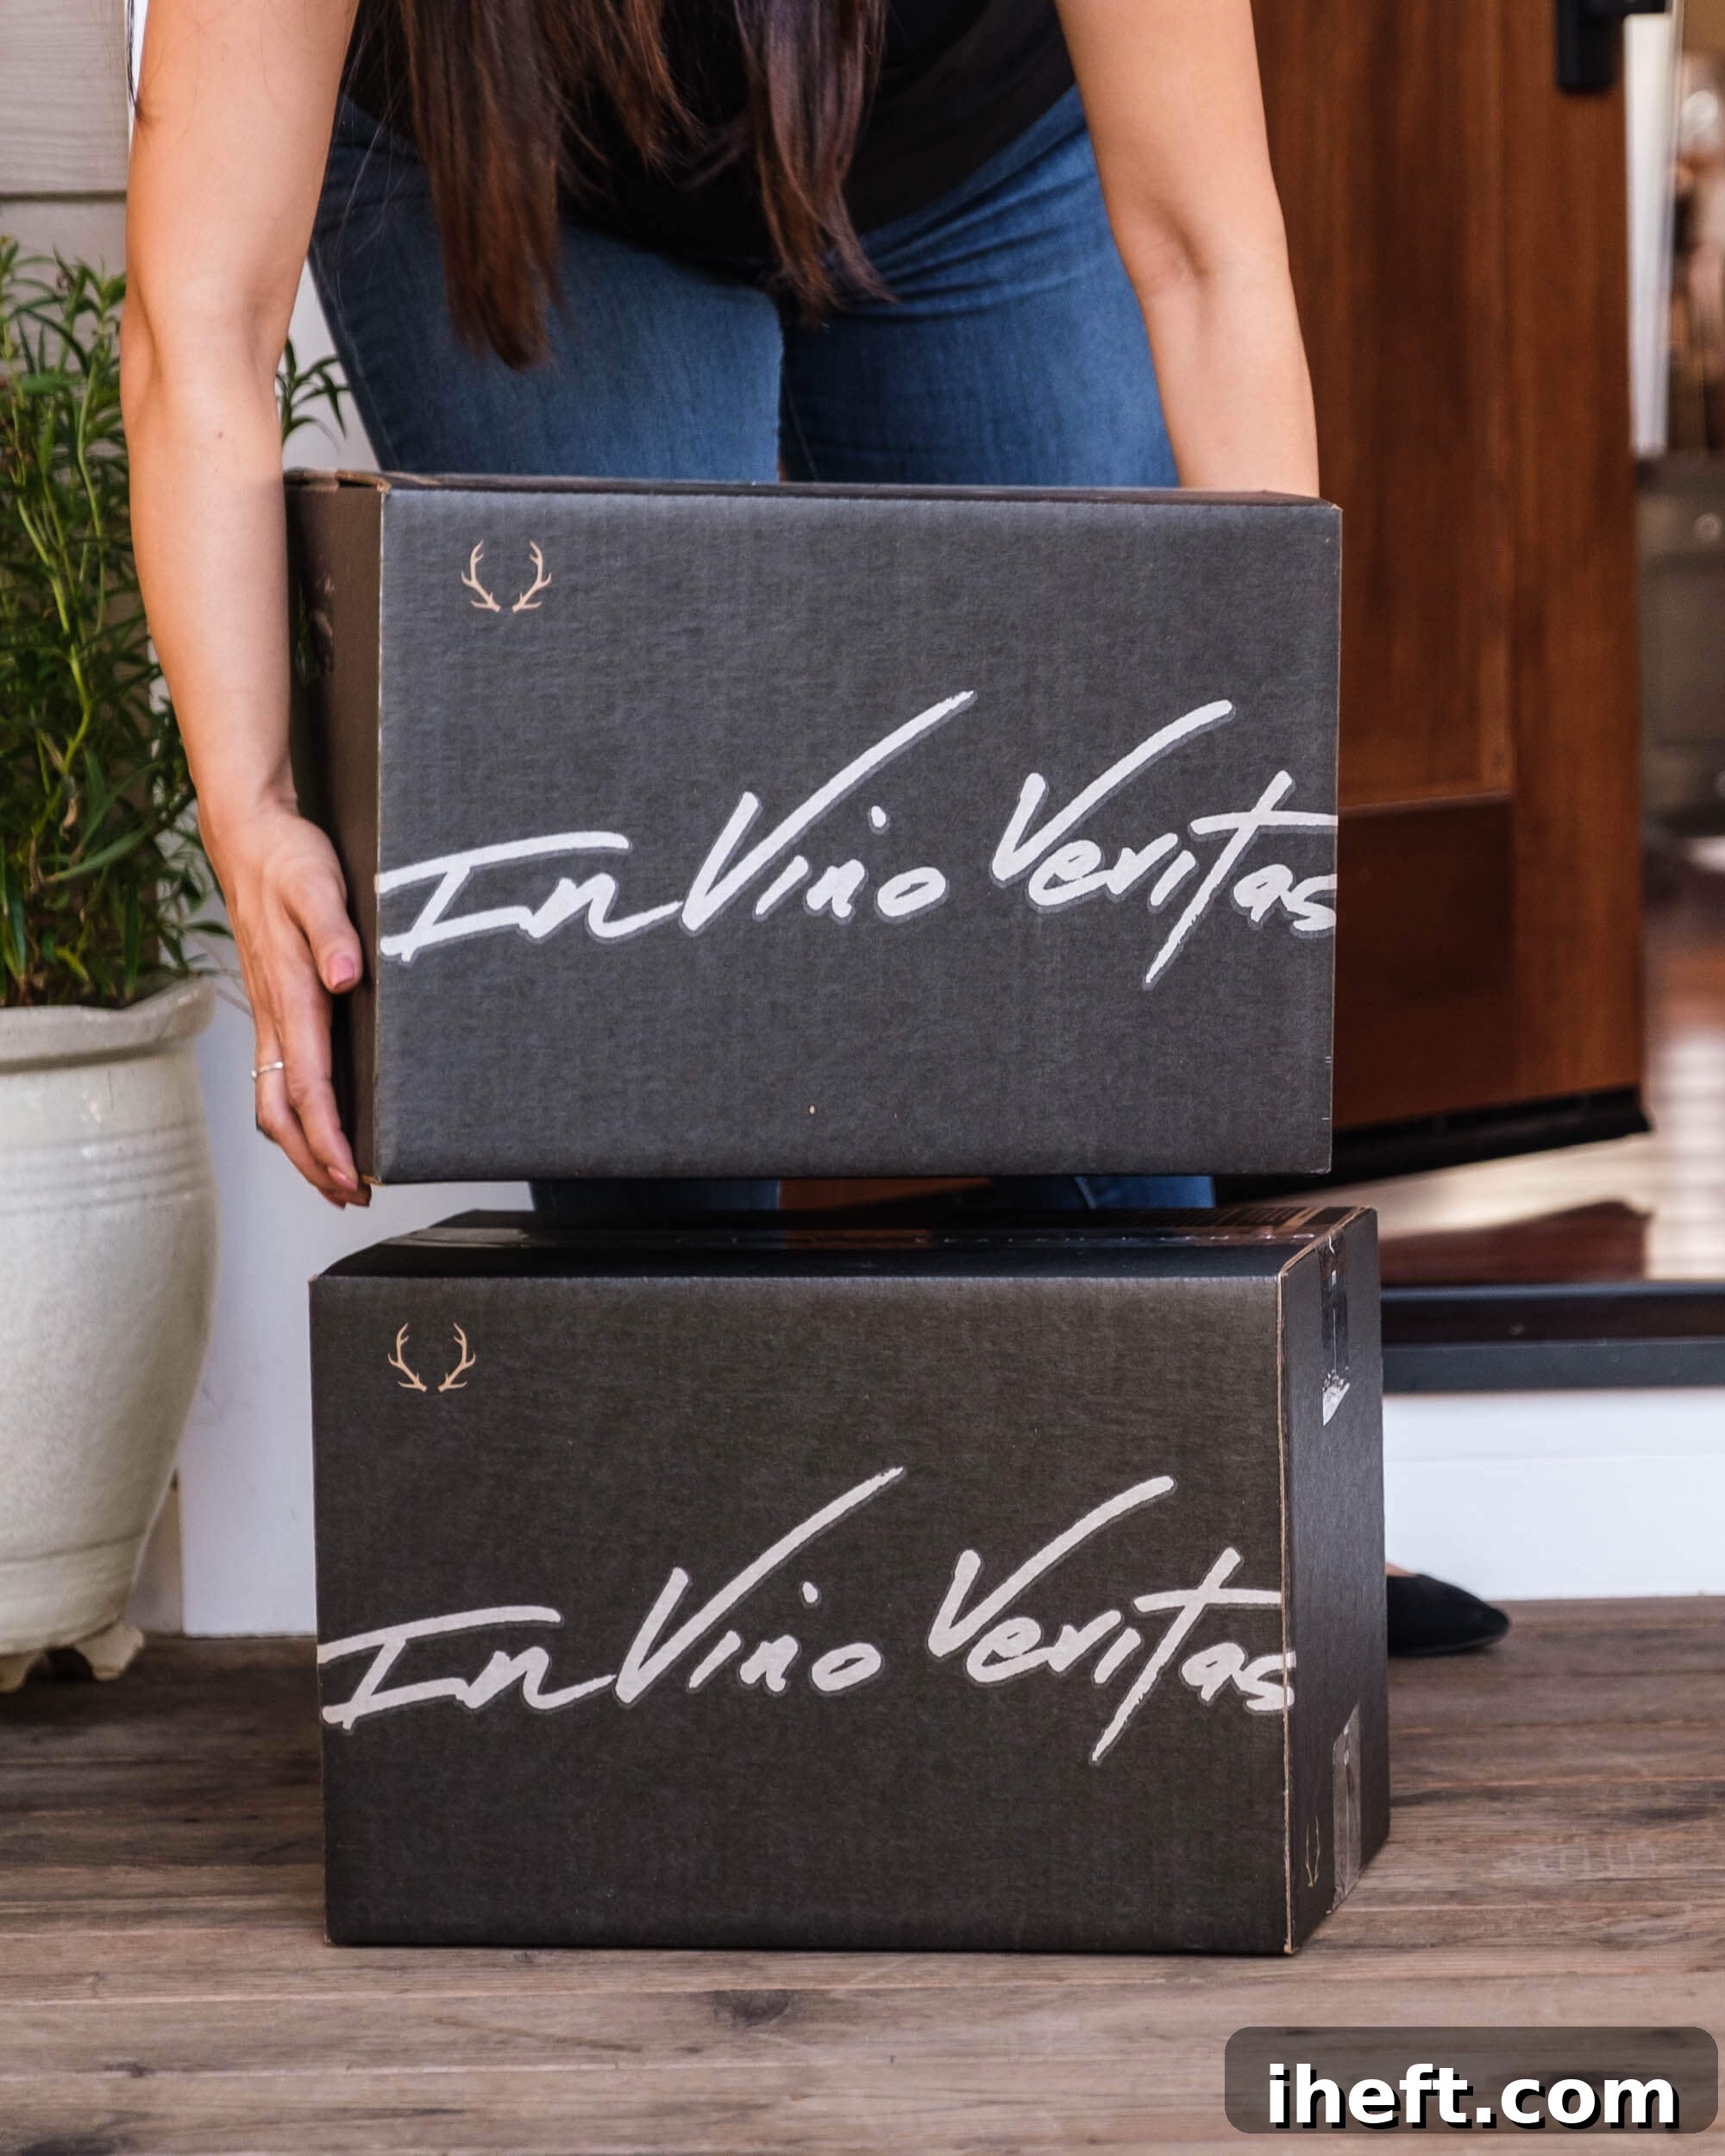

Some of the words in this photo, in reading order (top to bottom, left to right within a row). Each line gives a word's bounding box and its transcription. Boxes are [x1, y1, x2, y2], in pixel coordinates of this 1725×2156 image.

[376, 830, 684, 962] In
[681, 689, 975, 932] Vino
[991, 699, 1339, 984] Veritas
[317, 1605, 617, 1730] In
[615, 1466, 904, 1704] Vino
[927, 1475, 1297, 1762] Veritas
